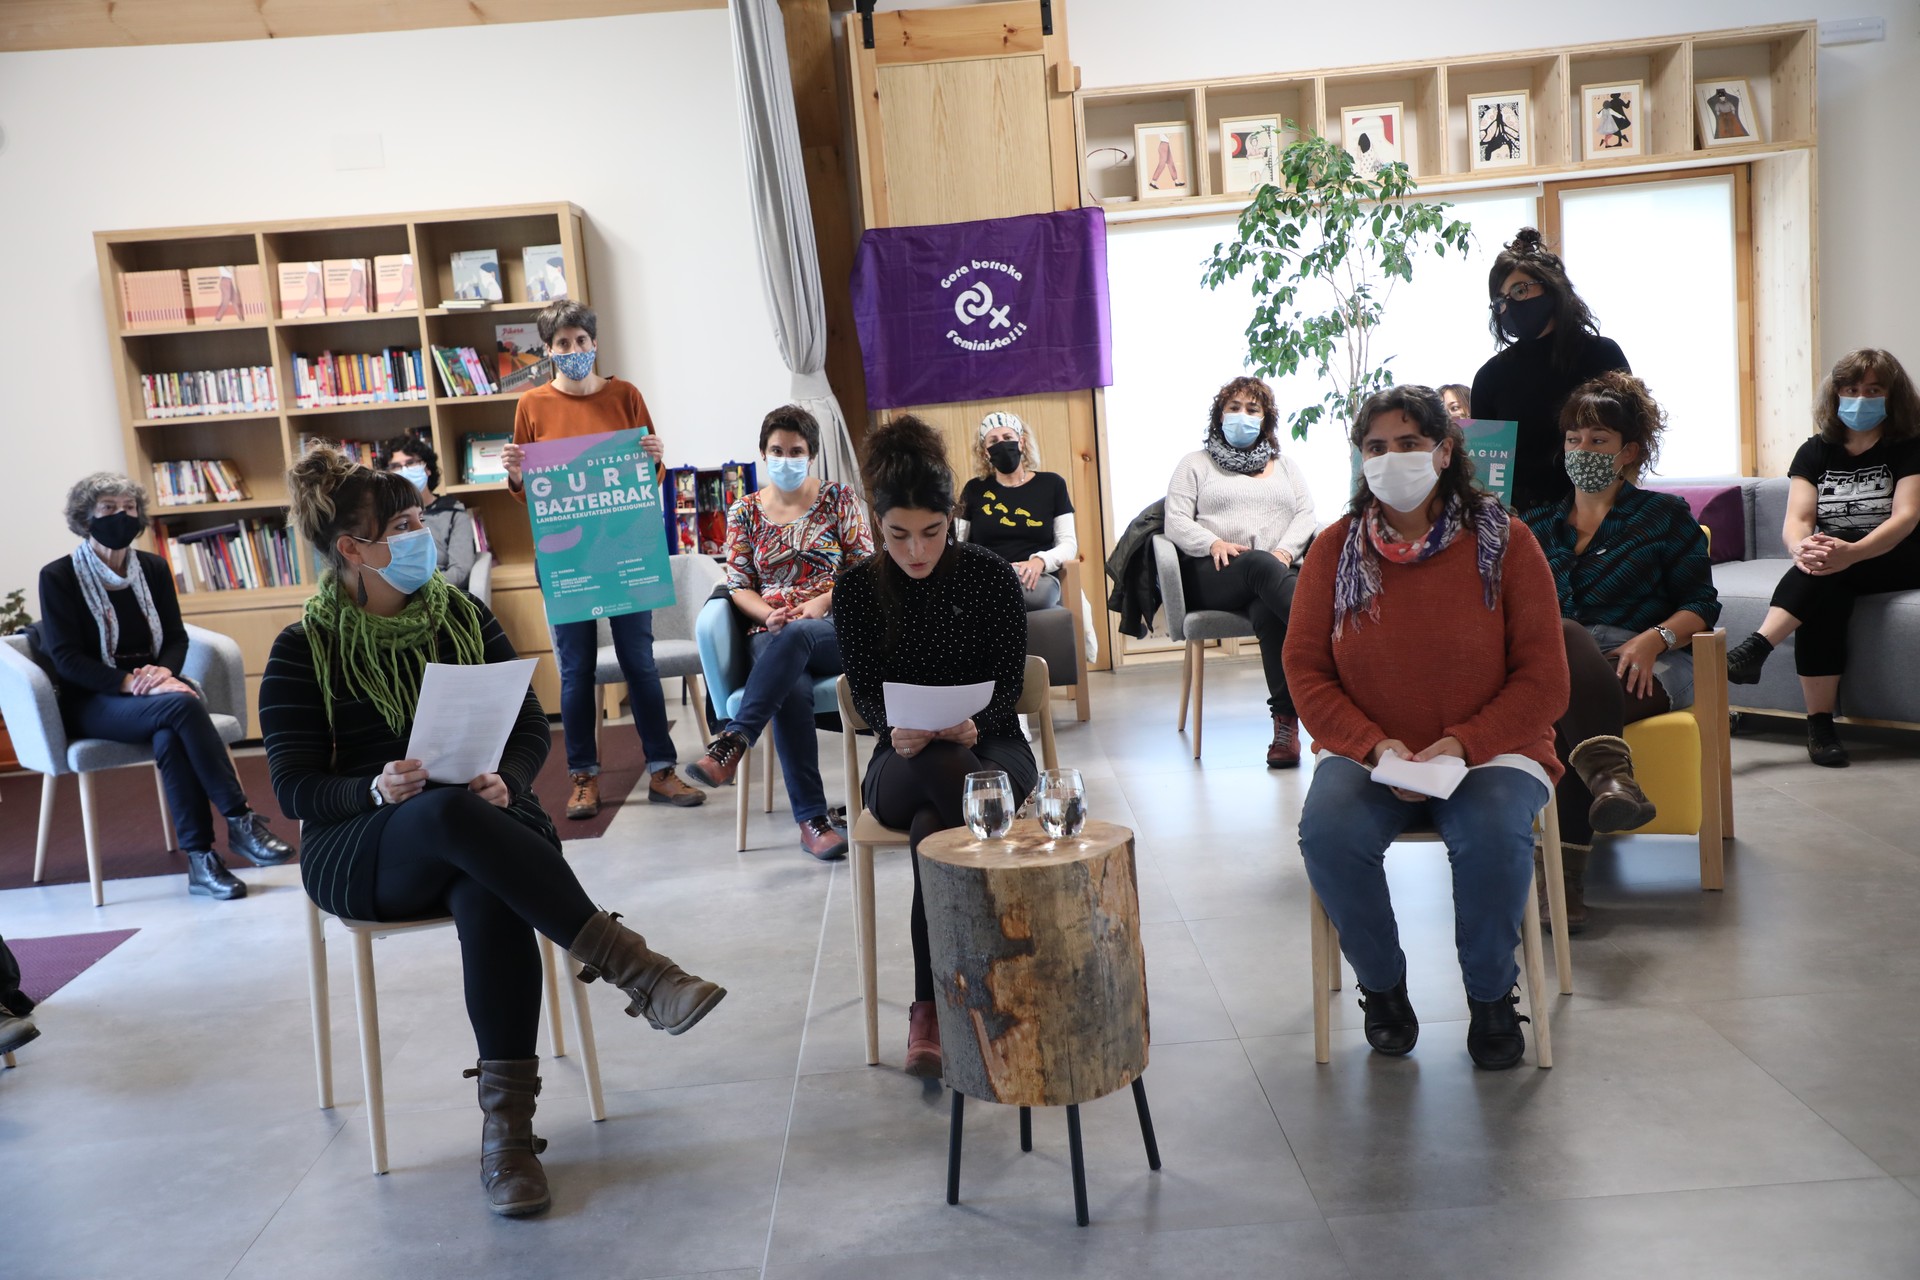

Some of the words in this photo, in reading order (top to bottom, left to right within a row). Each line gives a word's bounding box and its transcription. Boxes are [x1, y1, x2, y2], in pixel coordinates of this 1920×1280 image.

[941, 266, 969, 288] Gora
[972, 260, 1022, 281] borroka
[528, 463, 568, 475] ARAKA
[587, 451, 648, 467] DITZAGUN
[1468, 449, 1508, 459] AGUN
[531, 462, 651, 497] GURE
[534, 484, 655, 517] BAZTERRAK
[536, 513, 571, 524] LANBROAK
[572, 508, 612, 519] EZKUTATZEN
[612, 501, 655, 513] DIZKIGUNEAN
